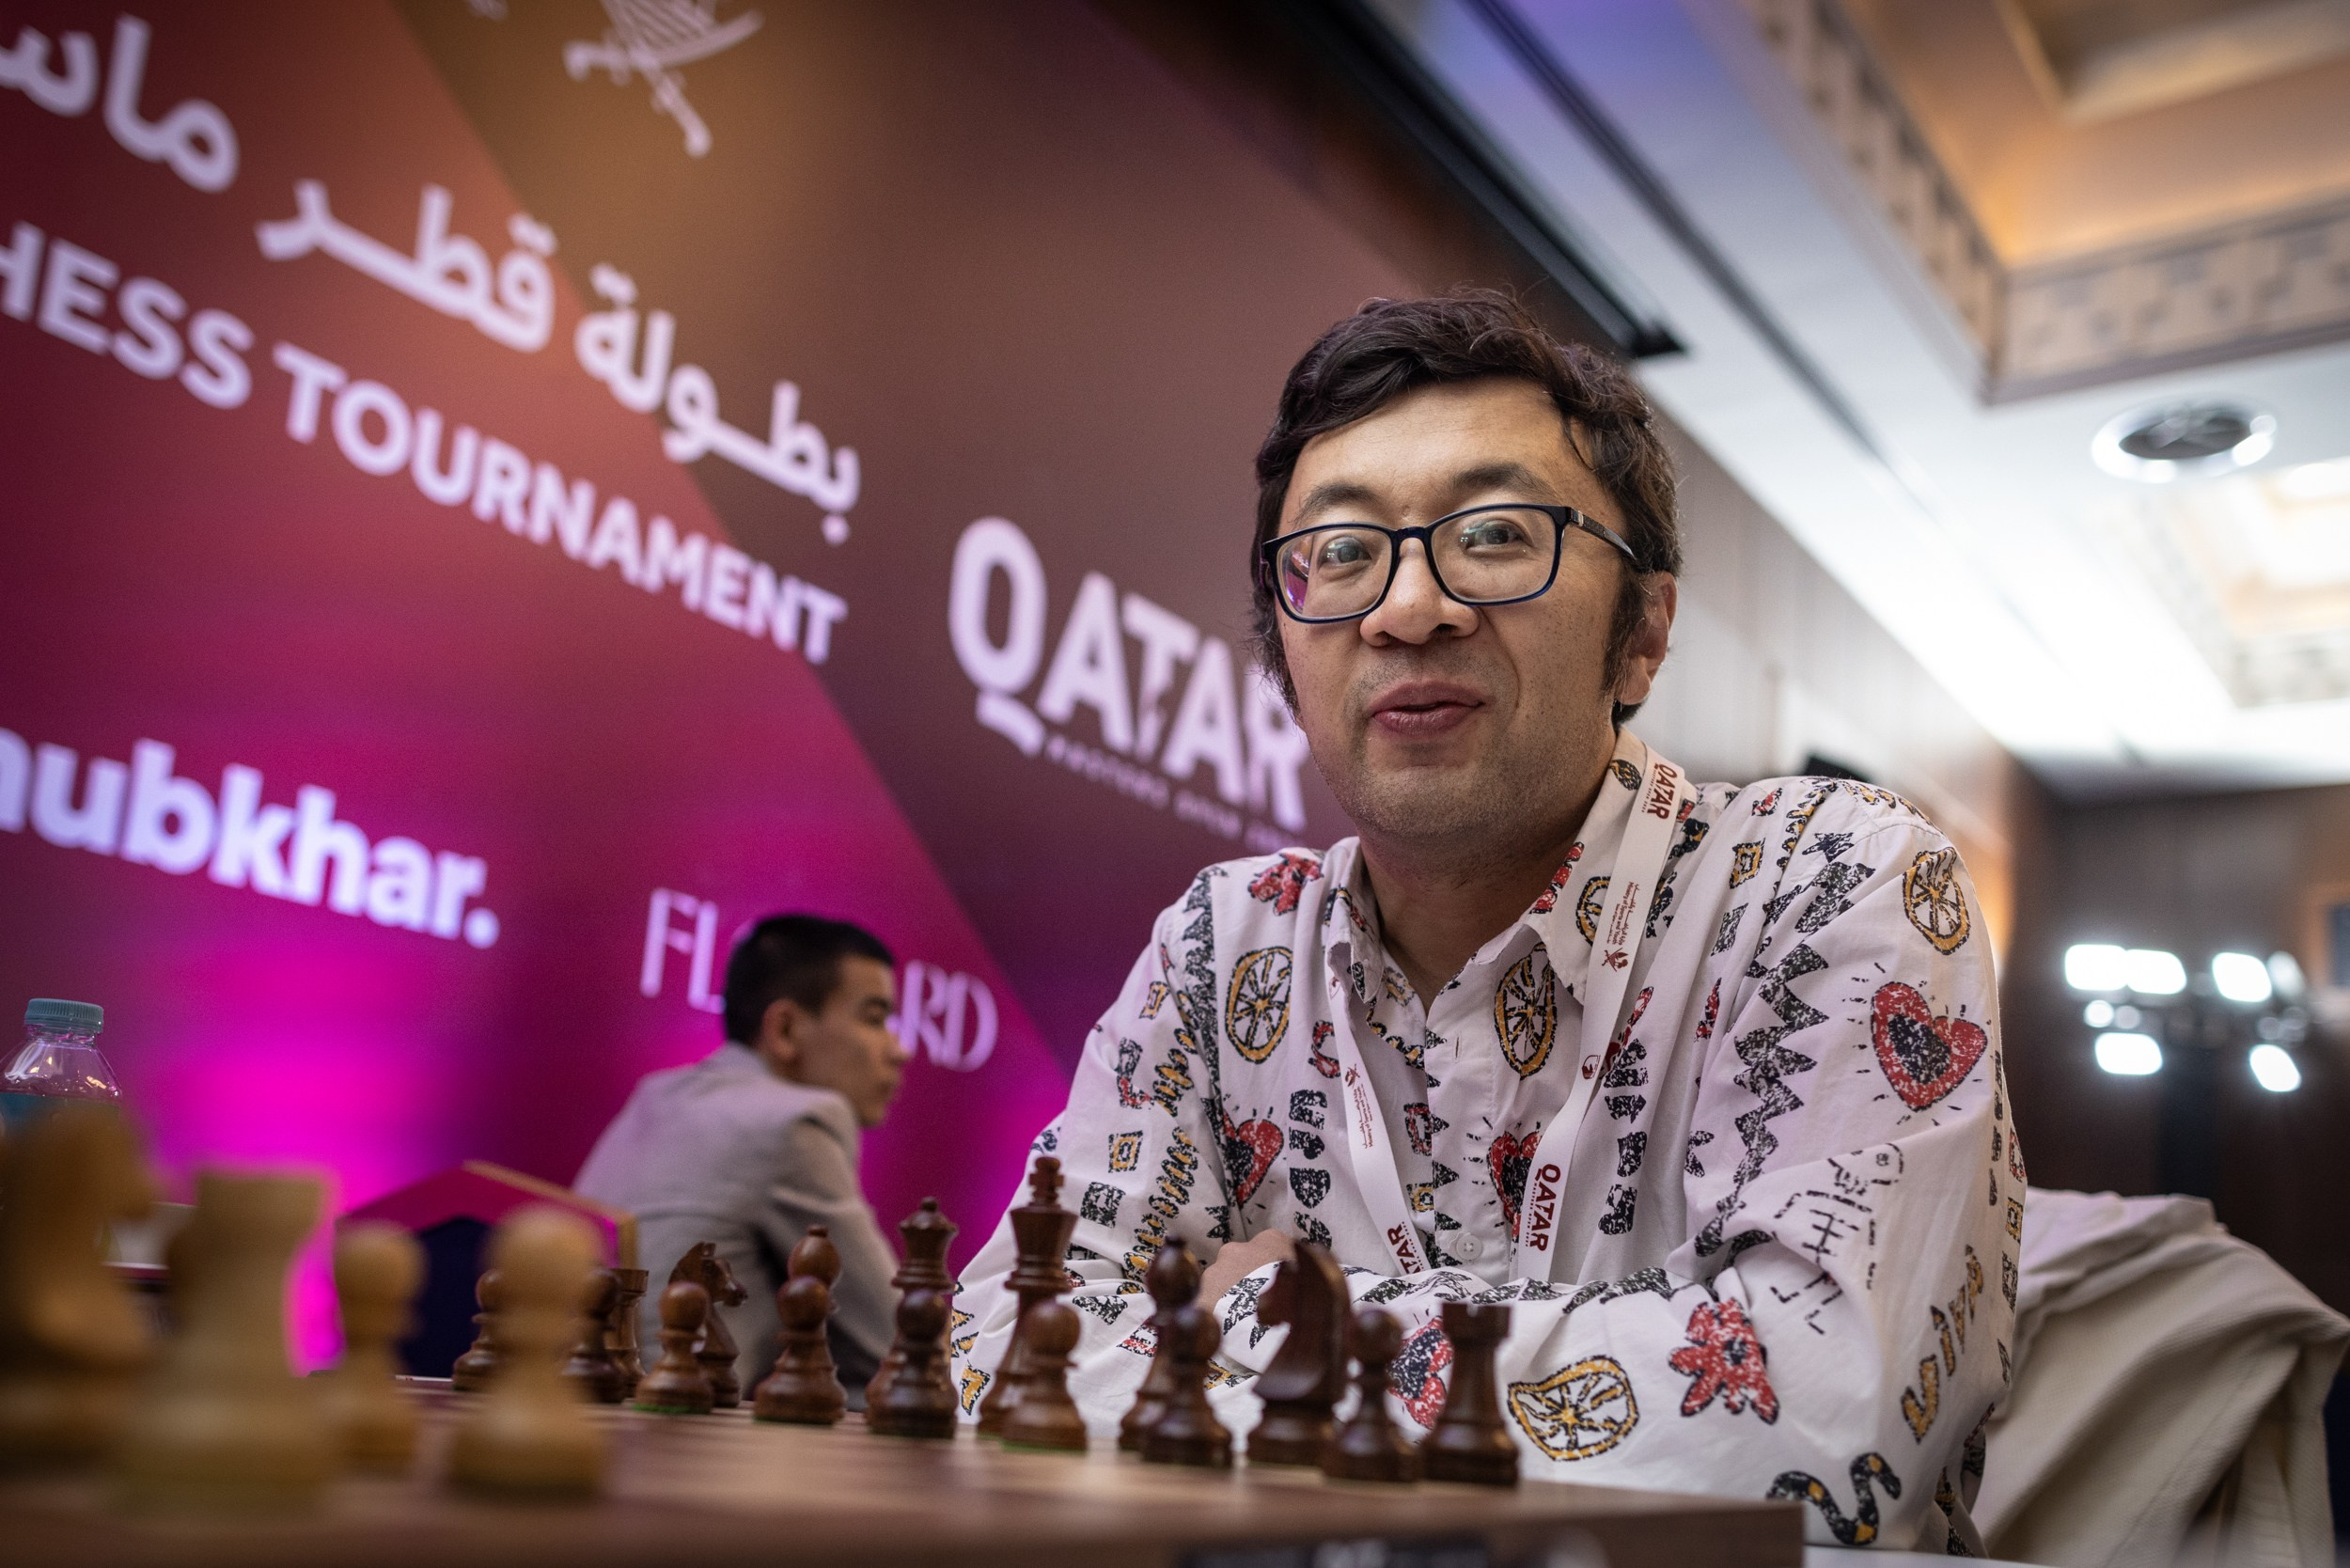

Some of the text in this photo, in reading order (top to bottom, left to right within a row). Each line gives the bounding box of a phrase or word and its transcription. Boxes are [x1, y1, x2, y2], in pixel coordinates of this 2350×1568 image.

[254, 179, 560, 353] قطر
[575, 263, 861, 543] بطولة
[272, 341, 849, 665] TOURNAMENT
[947, 515, 1312, 832] QATAR
[1647, 763, 1677, 819] QATAR
[639, 886, 999, 1074] FLRD
[1387, 1223, 1421, 1275] TAR
[1529, 1164, 1561, 1251] QATAR
